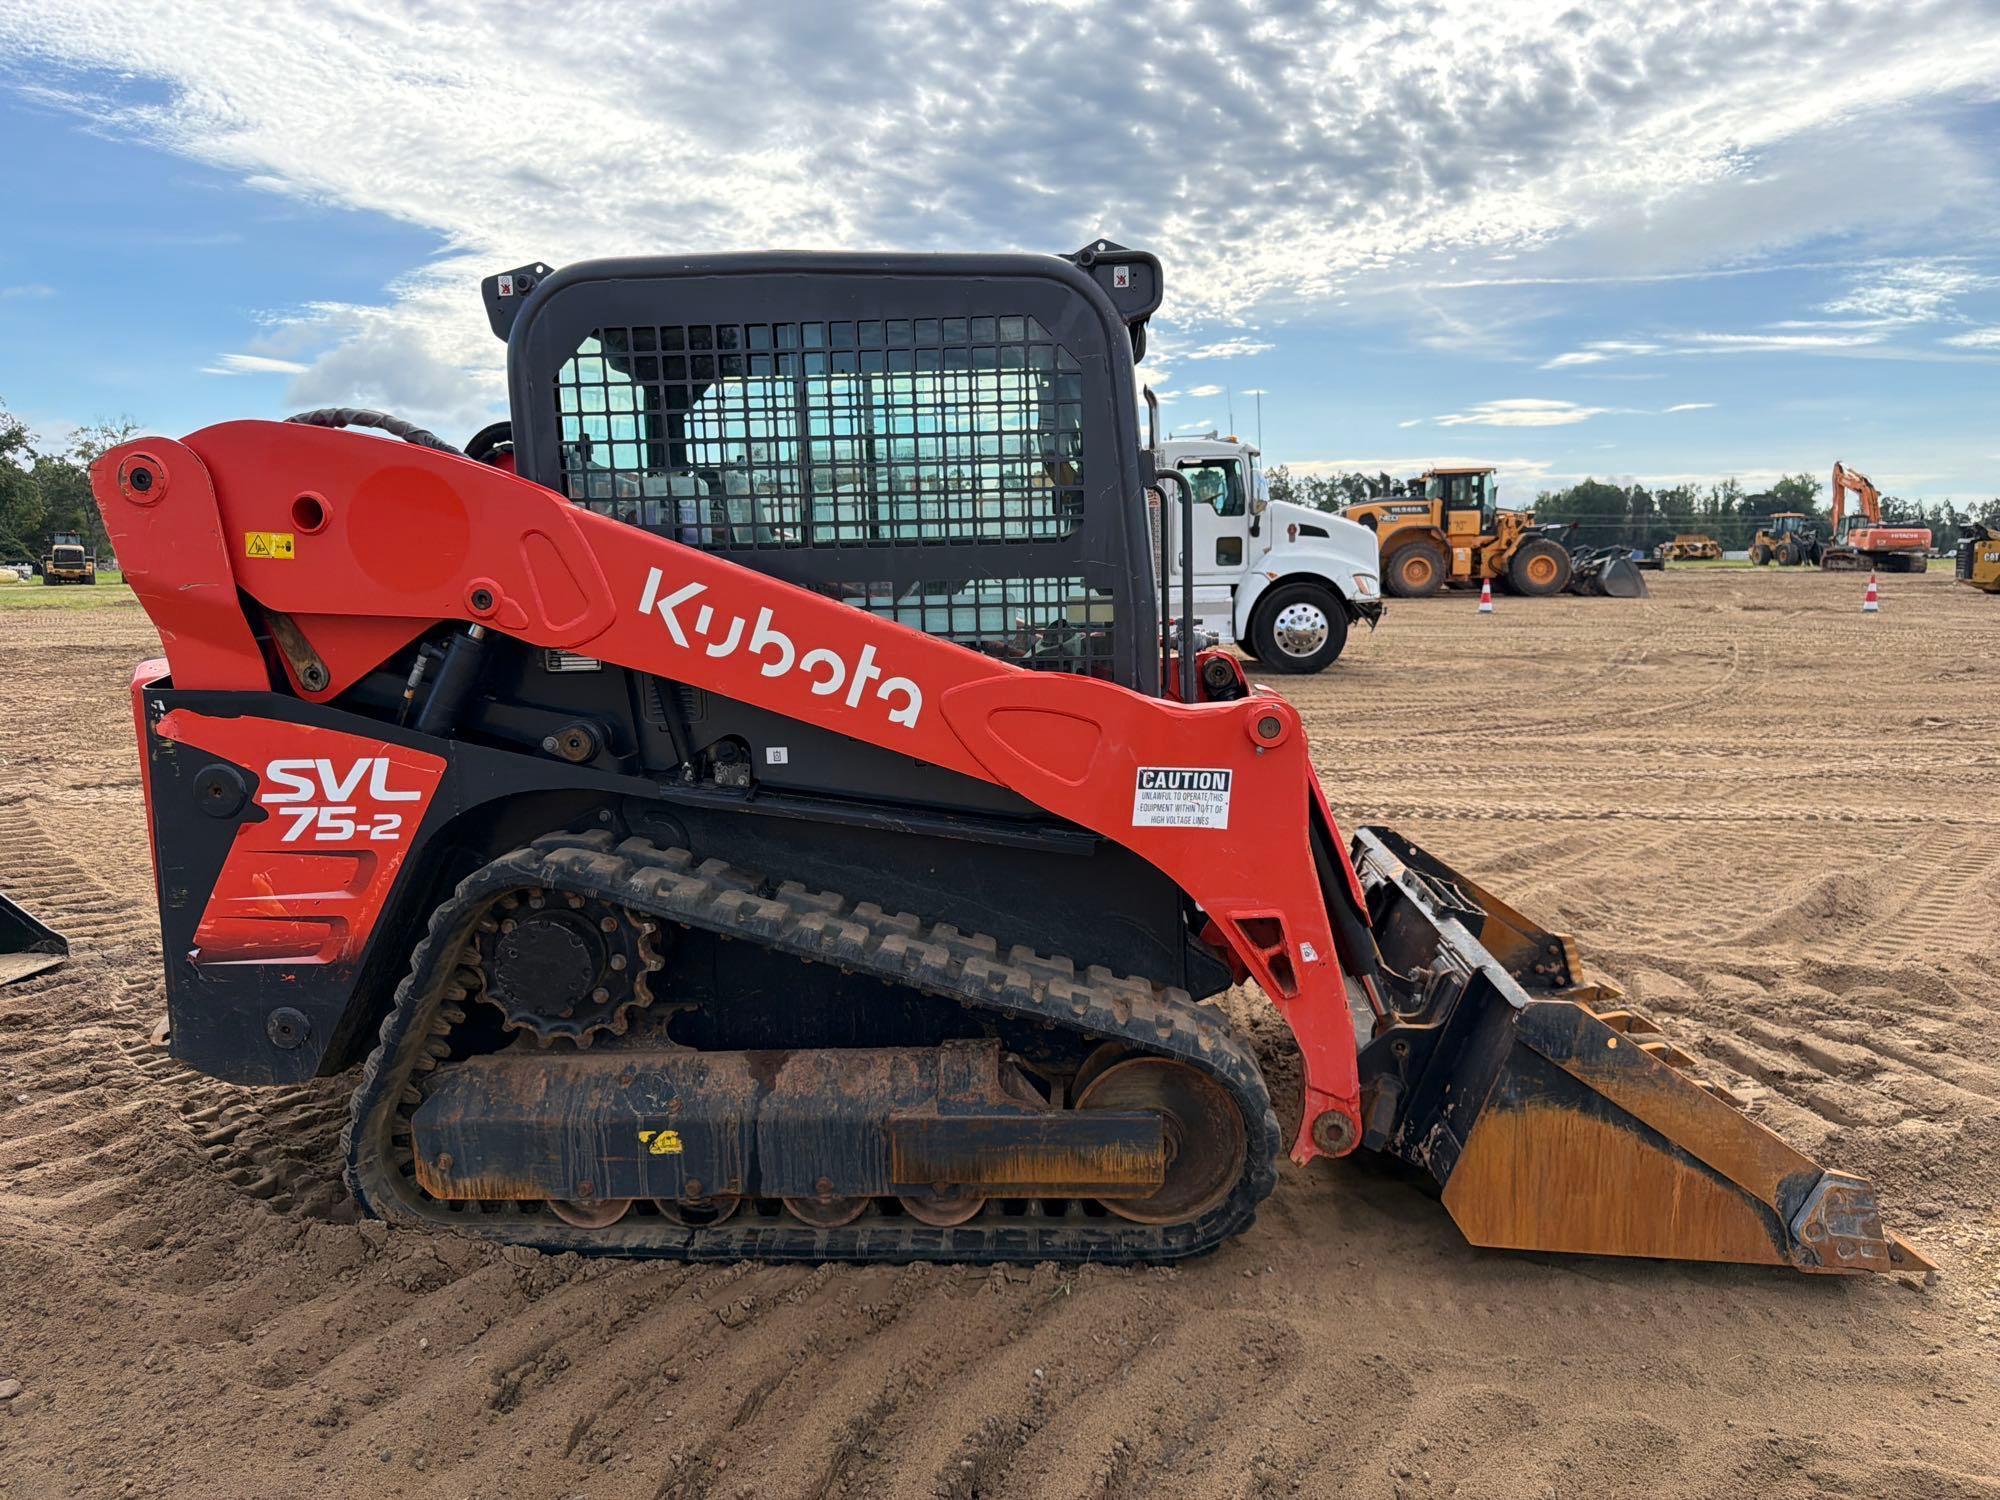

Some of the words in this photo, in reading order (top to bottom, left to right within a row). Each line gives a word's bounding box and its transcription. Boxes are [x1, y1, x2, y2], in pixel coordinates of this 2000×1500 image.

[1984, 552, 2000, 562] CAT
[638, 566, 923, 729] Kubota
[261, 758, 422, 803] SVL
[1142, 771, 1225, 790] CAUTION
[1141, 791, 1172, 801] UNLAWFUL
[1173, 792, 1181, 801] TO
[1182, 792, 1209, 802] OPERATE
[1210, 792, 1224, 803] THIS
[1139, 803, 1174, 812] EQUIPMENT
[1175, 804, 1196, 812] WITHIN
[1214, 805, 1223, 814] OF
[278, 806, 402, 842] 75-2
[1150, 816, 1165, 825] HIGH
[1166, 816, 1192, 825] VOLTAGE
[1192, 817, 1210, 826] LINES
